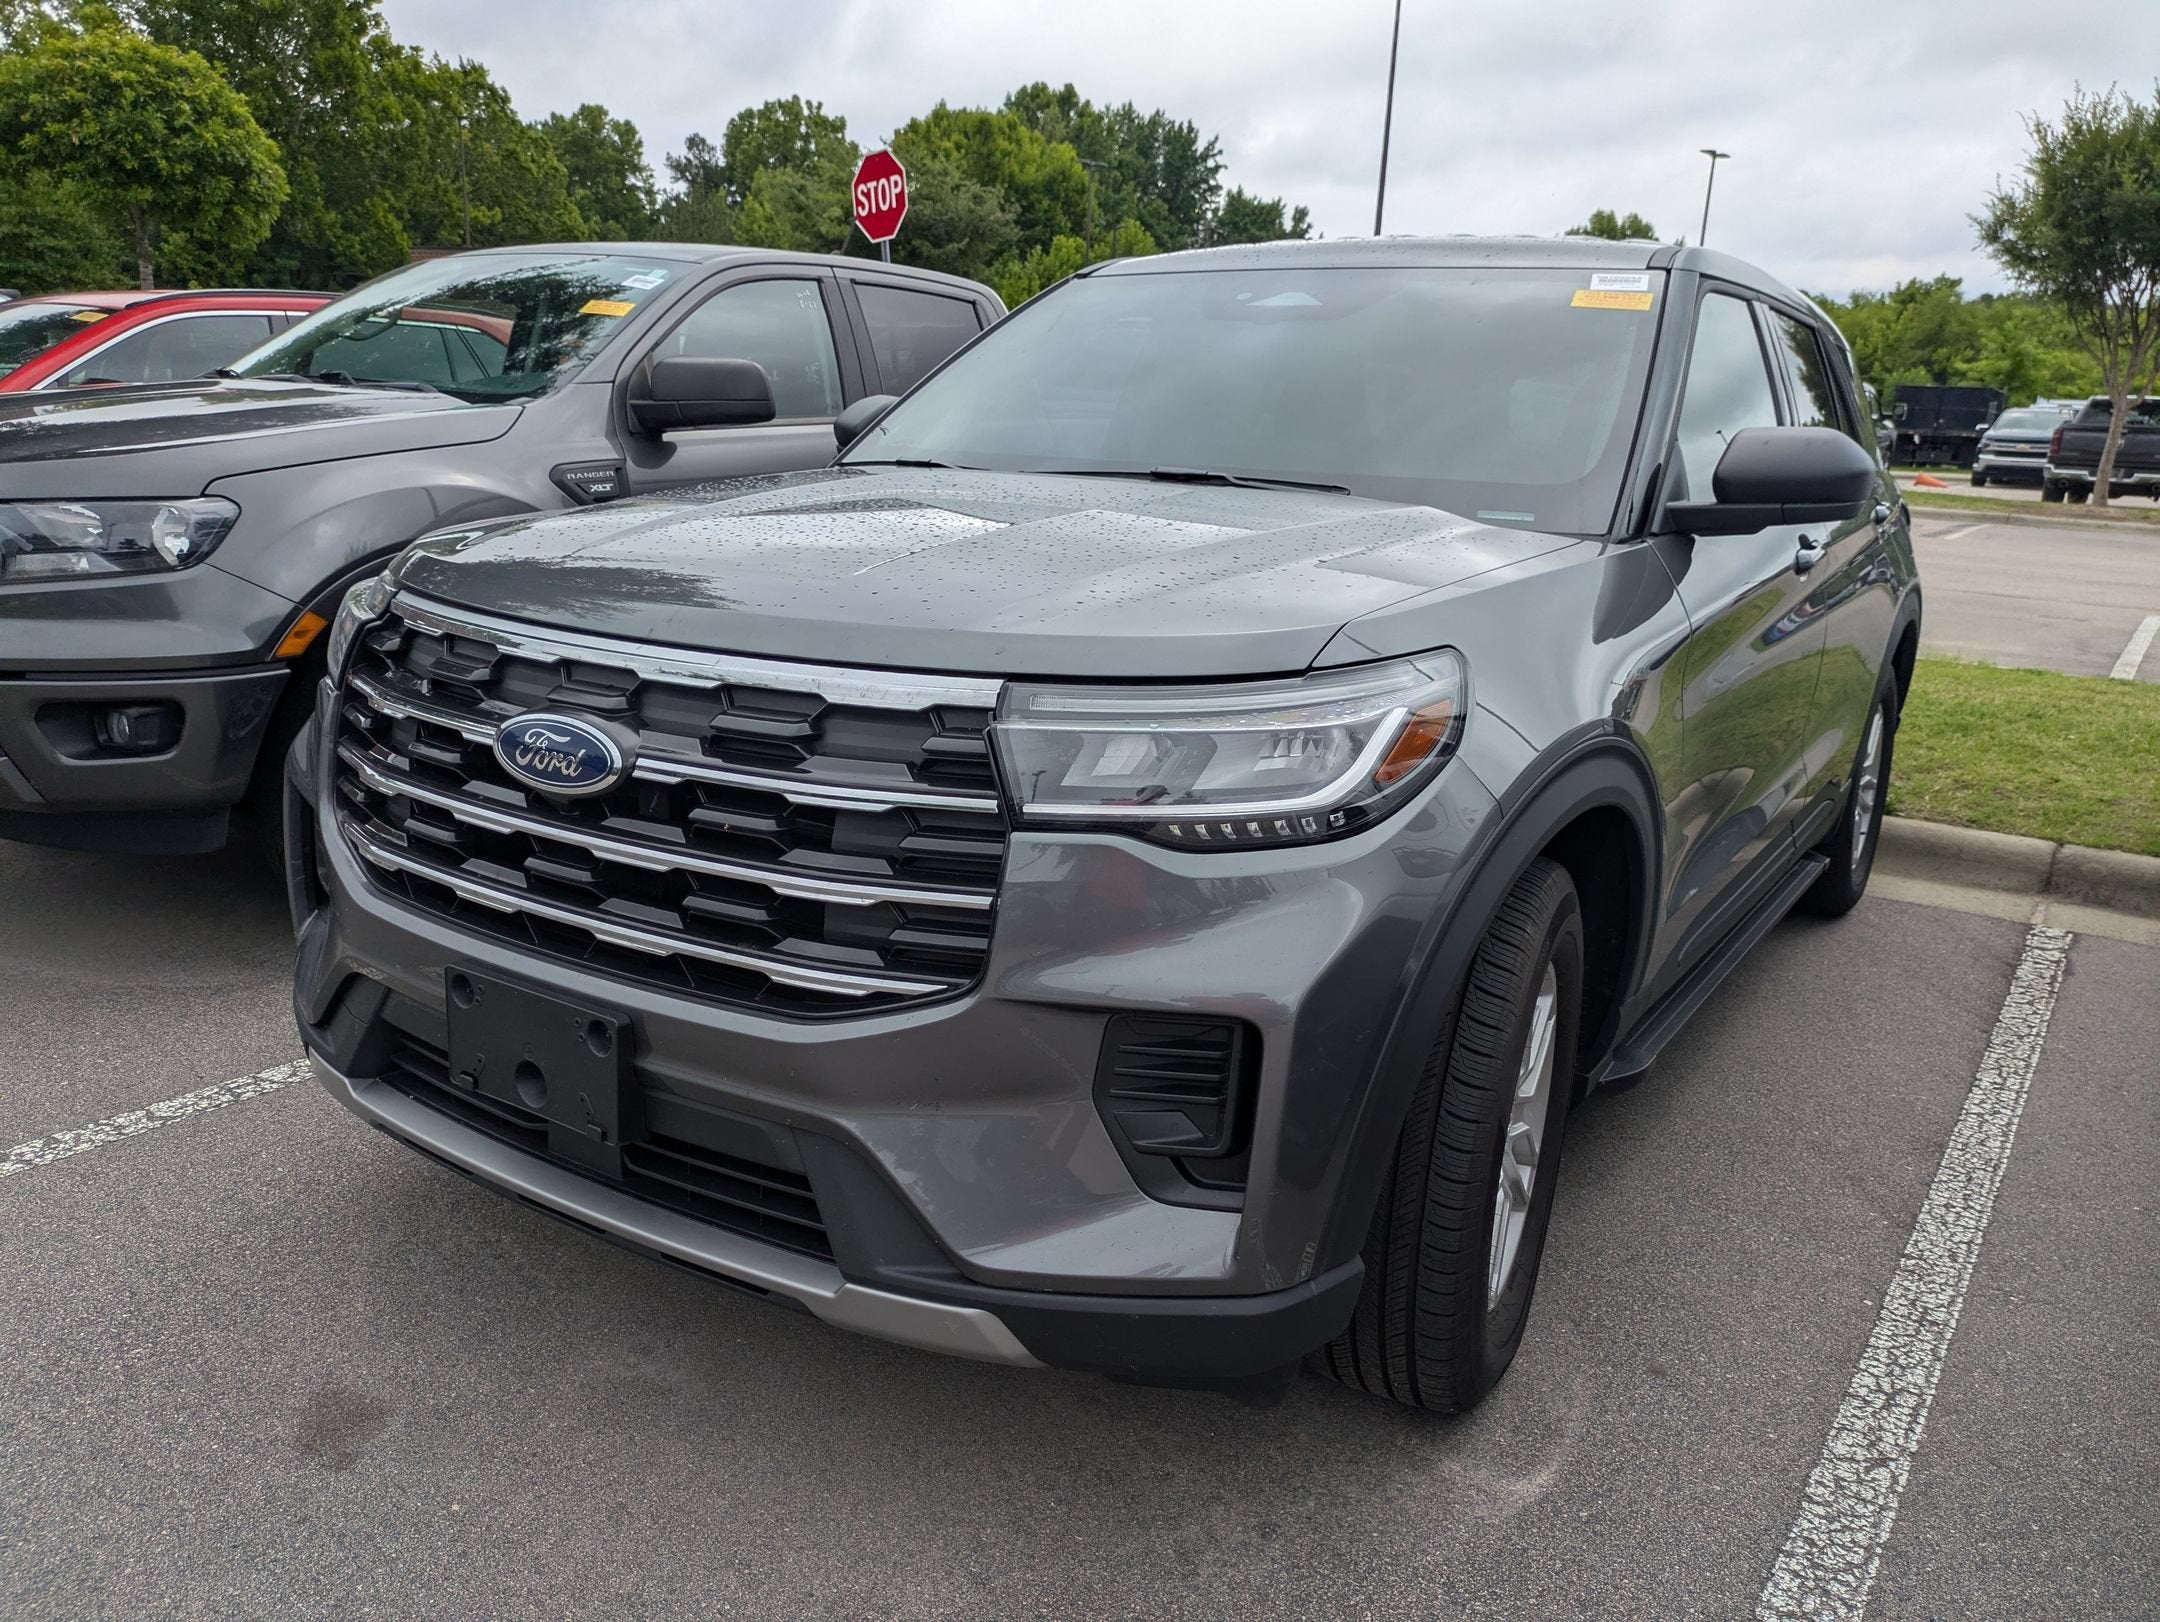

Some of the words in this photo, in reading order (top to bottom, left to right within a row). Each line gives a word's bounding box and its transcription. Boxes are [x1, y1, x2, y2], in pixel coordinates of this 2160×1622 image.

[857, 174, 902, 217] STOP
[567, 470, 614, 480] RANGER
[589, 483, 614, 493] XLT
[515, 728, 587, 778] Ford
